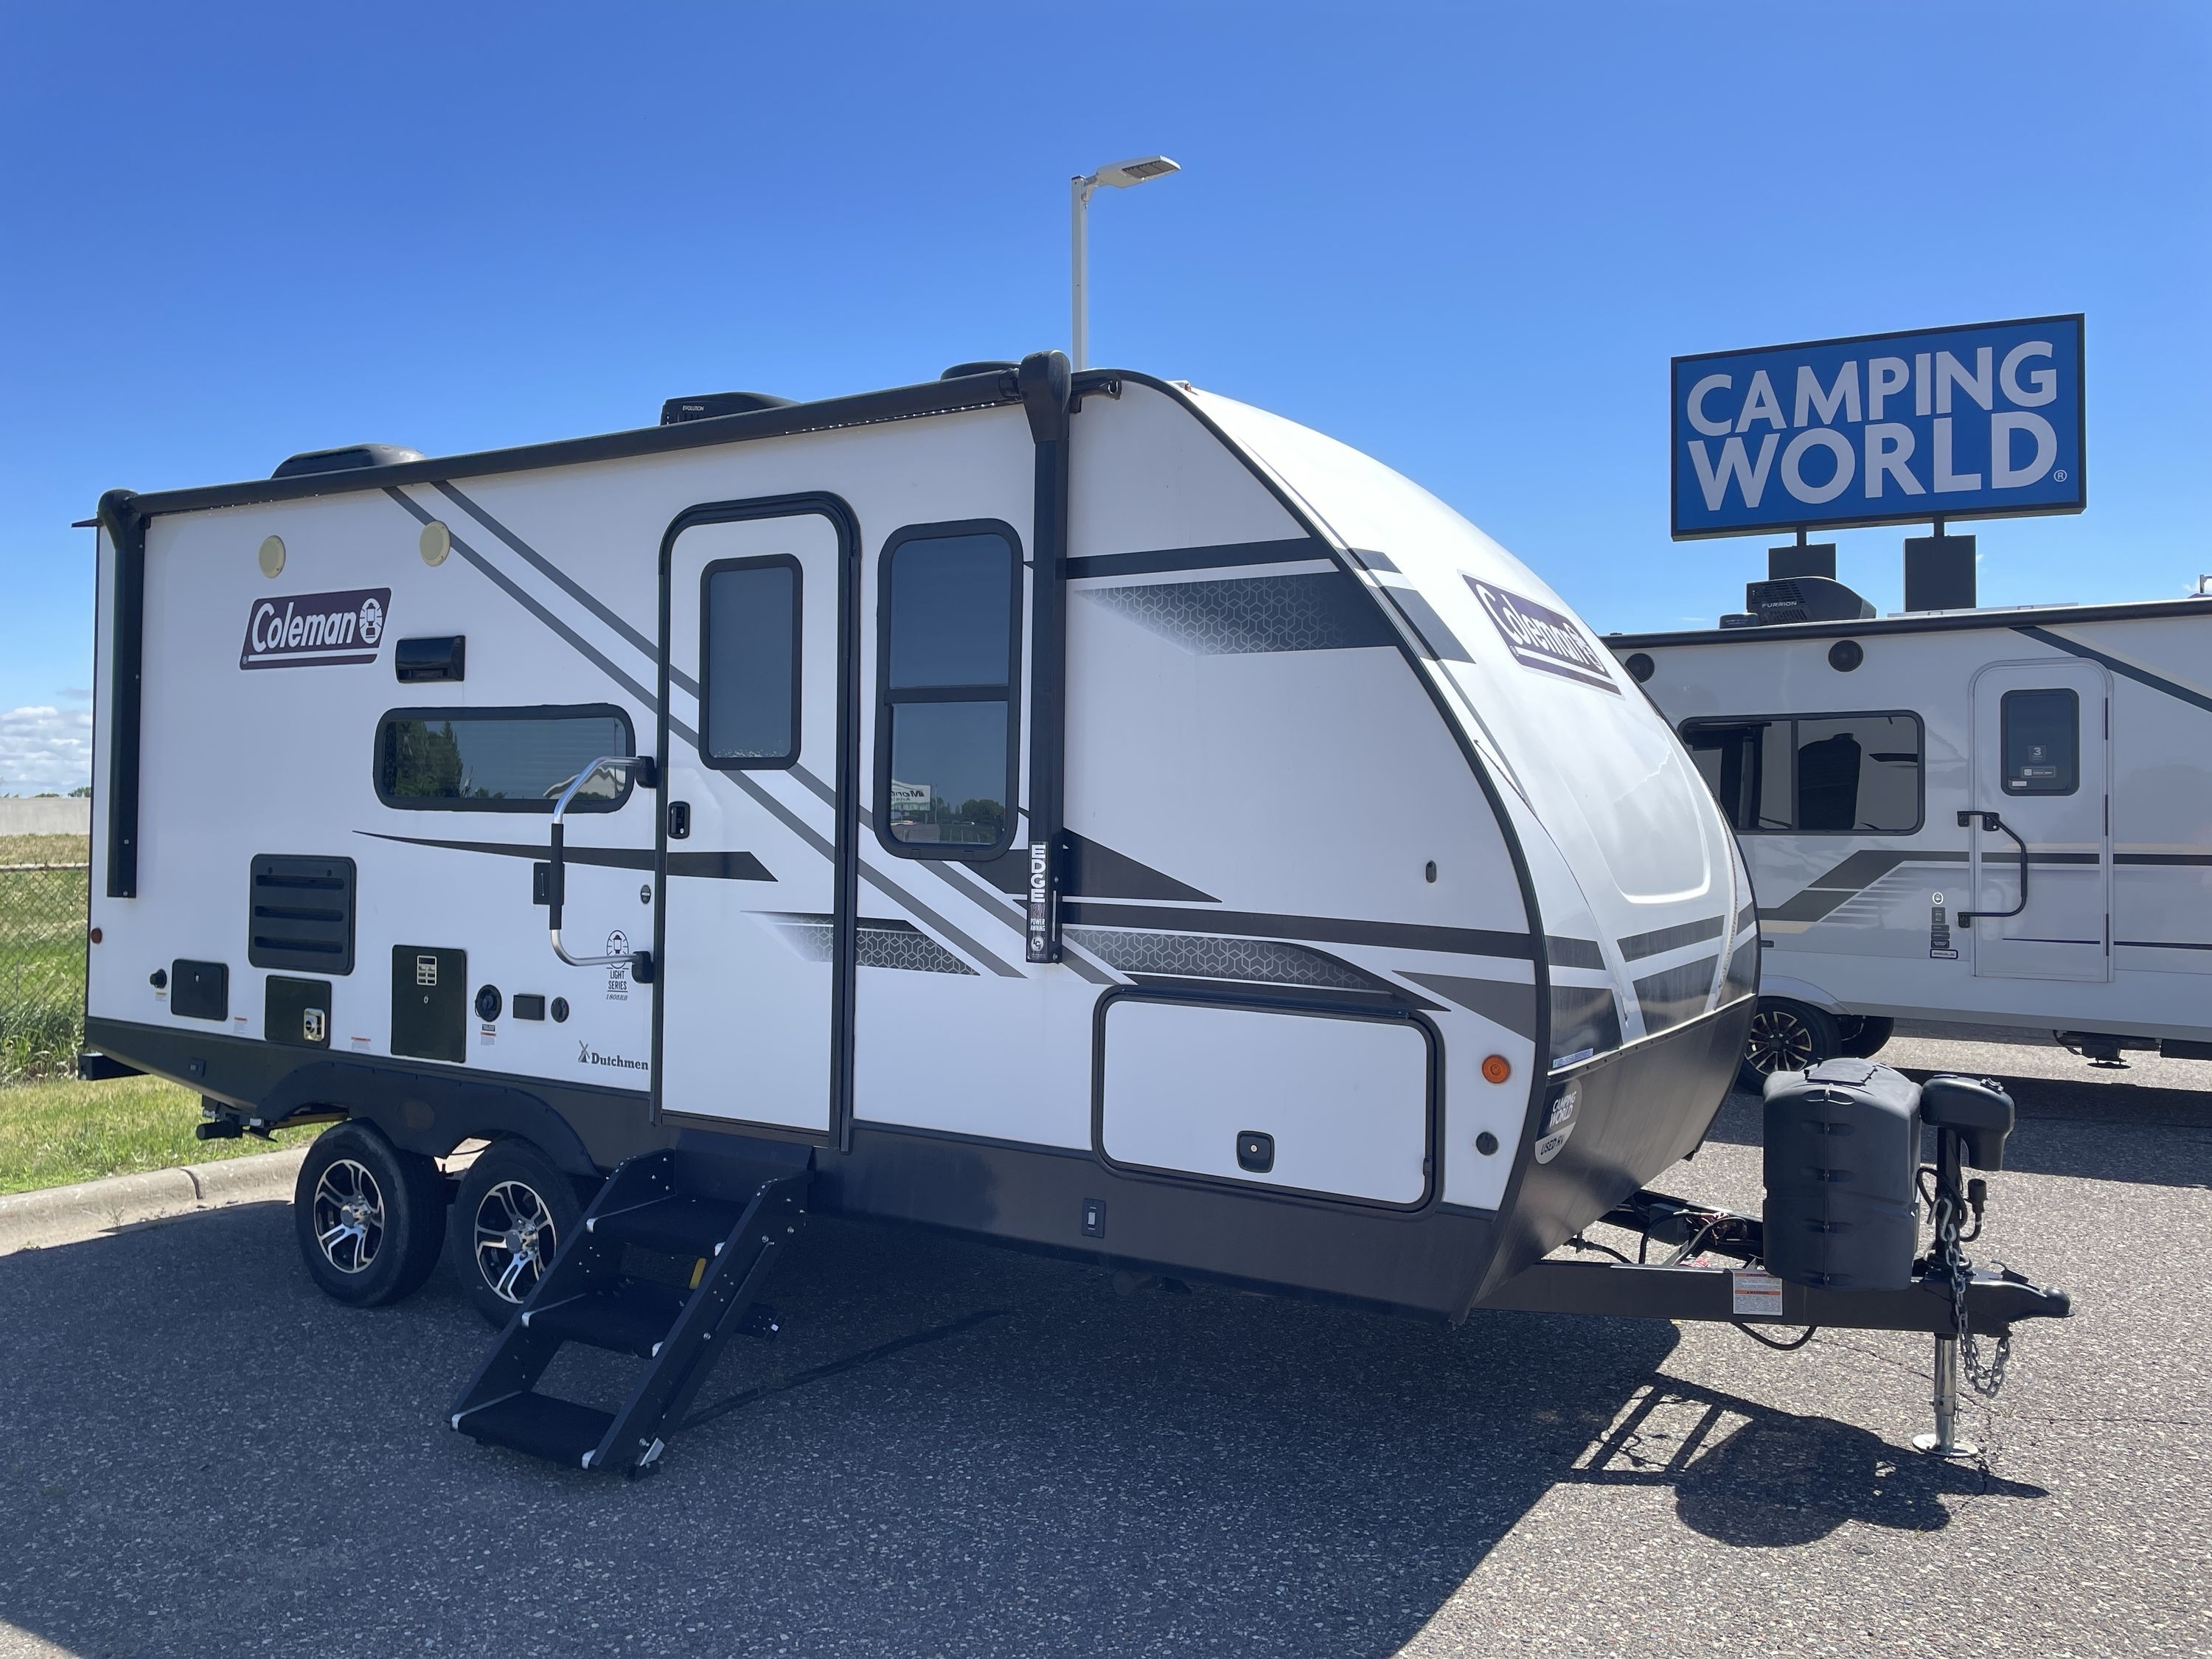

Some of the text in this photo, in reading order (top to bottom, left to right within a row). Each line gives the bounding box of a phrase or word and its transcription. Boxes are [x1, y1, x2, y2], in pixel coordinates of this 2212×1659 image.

[1687, 341, 2057, 437] CAMPING
[1688, 411, 2057, 511] WORLD
[251, 602, 357, 653] Coleman
[1475, 583, 1590, 665] Coleman
[1030, 844, 1046, 903] EDGE
[608, 980, 627, 990] SERIES
[610, 970, 625, 979] LIGHT
[591, 1051, 649, 1071] Dutchmen
[1552, 1091, 1577, 1113] CAMPING
[1549, 1104, 1573, 1128] WORLD
[1540, 1138, 1557, 1155] USED
